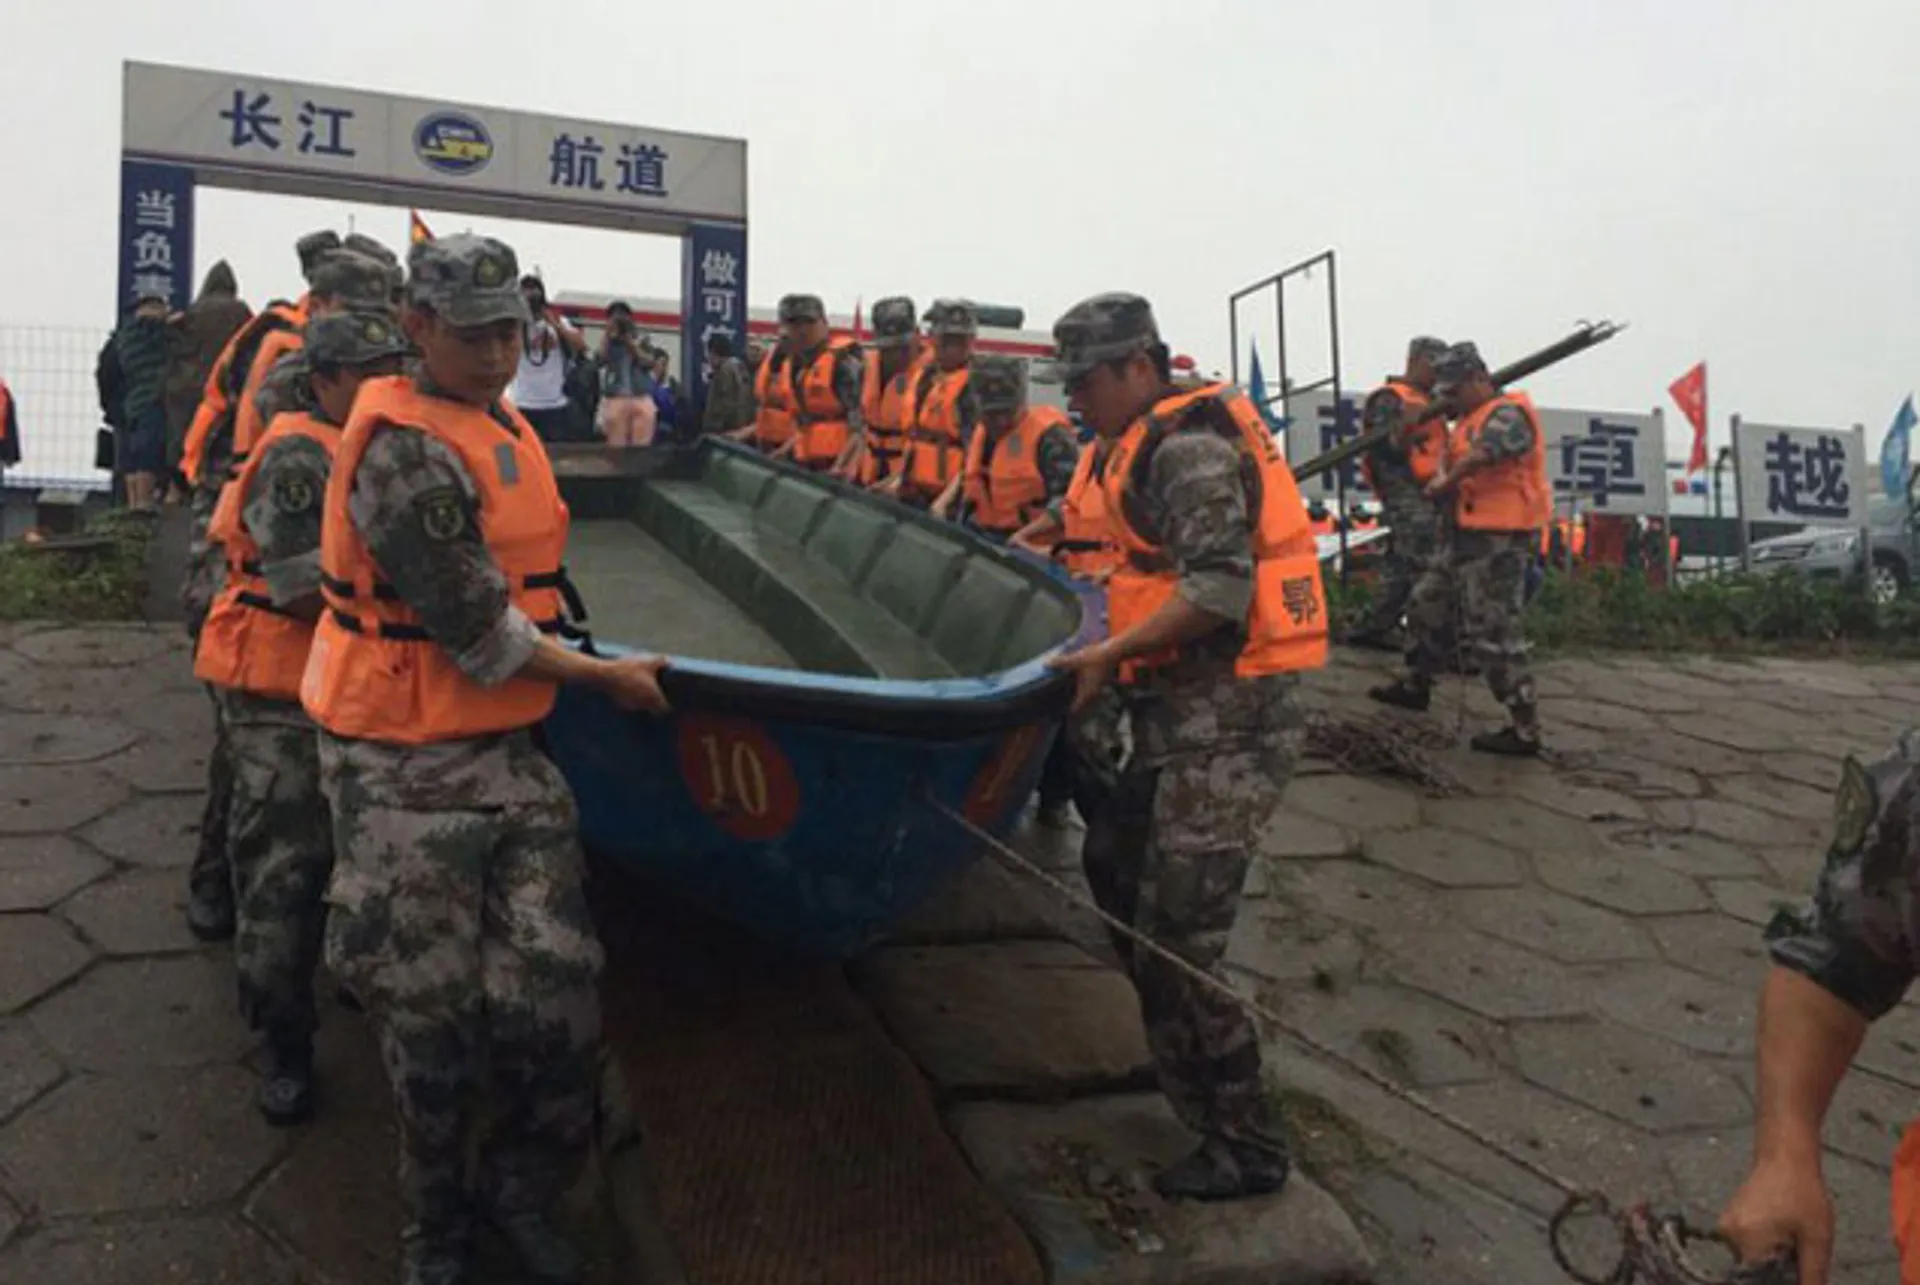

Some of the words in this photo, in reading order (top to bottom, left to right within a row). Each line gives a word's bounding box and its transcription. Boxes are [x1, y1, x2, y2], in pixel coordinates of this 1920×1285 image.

[219, 89, 356, 157] 长江
[549, 133, 669, 198] 航道
[1553, 418, 1646, 506] 卓
[1765, 431, 1849, 518] 越
[700, 734, 768, 818] 10
